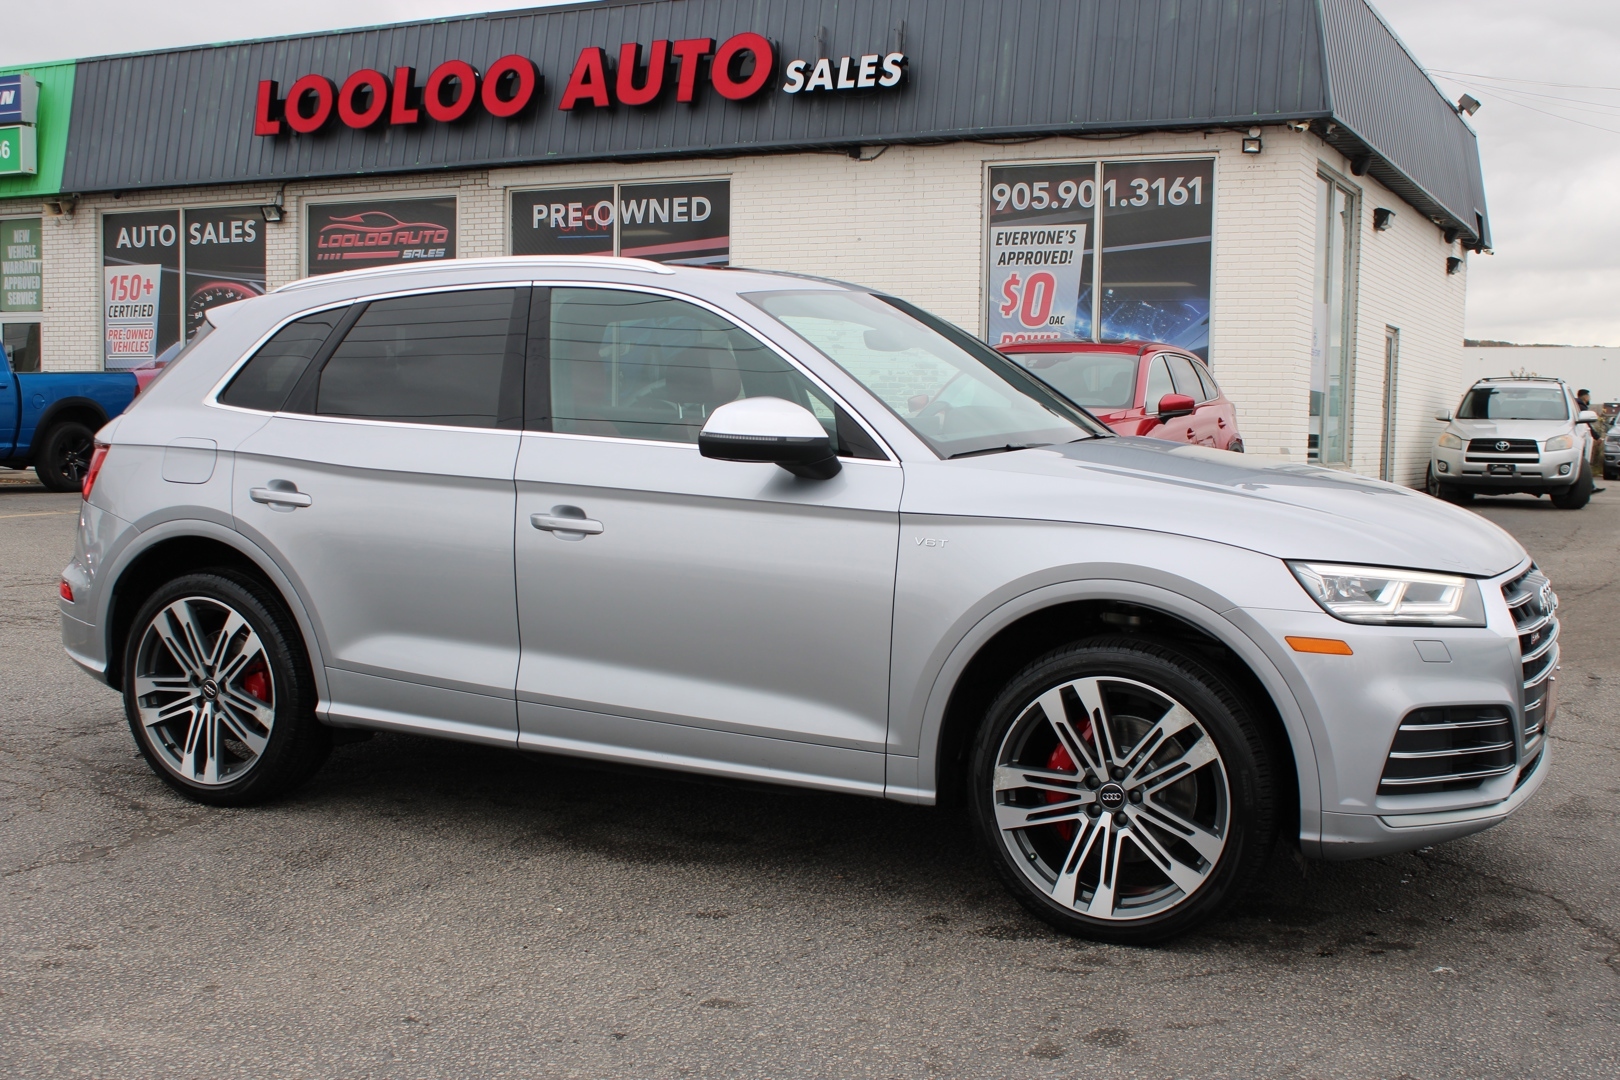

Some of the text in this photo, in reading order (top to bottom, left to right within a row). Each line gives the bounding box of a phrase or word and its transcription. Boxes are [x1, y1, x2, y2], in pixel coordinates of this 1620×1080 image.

[254, 32, 905, 136] LOOLOO AUTO SALES
[0, 90, 15, 105] N
[0, 140, 10, 159] 6
[992, 176, 1203, 211] 905.901.3161
[532, 196, 712, 229] PRE-OWNED
[13, 229, 31, 243] NEW
[116, 220, 257, 249] AUTO SALES
[317, 230, 449, 248] LOOLOO AUTO
[995, 229, 1077, 246] EVERYONE'S
[7, 245, 37, 259] VEHICLE
[402, 248, 446, 259] SALES
[997, 250, 1073, 266] APPROVED!
[3, 260, 42, 275] WARRANTY
[4, 276, 41, 290] APPROVED
[109, 274, 154, 302] 150+
[7, 291, 37, 305] SERVICE
[1001, 272, 1055, 327] $0
[108, 304, 154, 318] CERTIFIED
[1049, 315, 1066, 326] OAC
[108, 328, 154, 341] PRE-OWNED
[112, 341, 150, 354] VEHICLES
